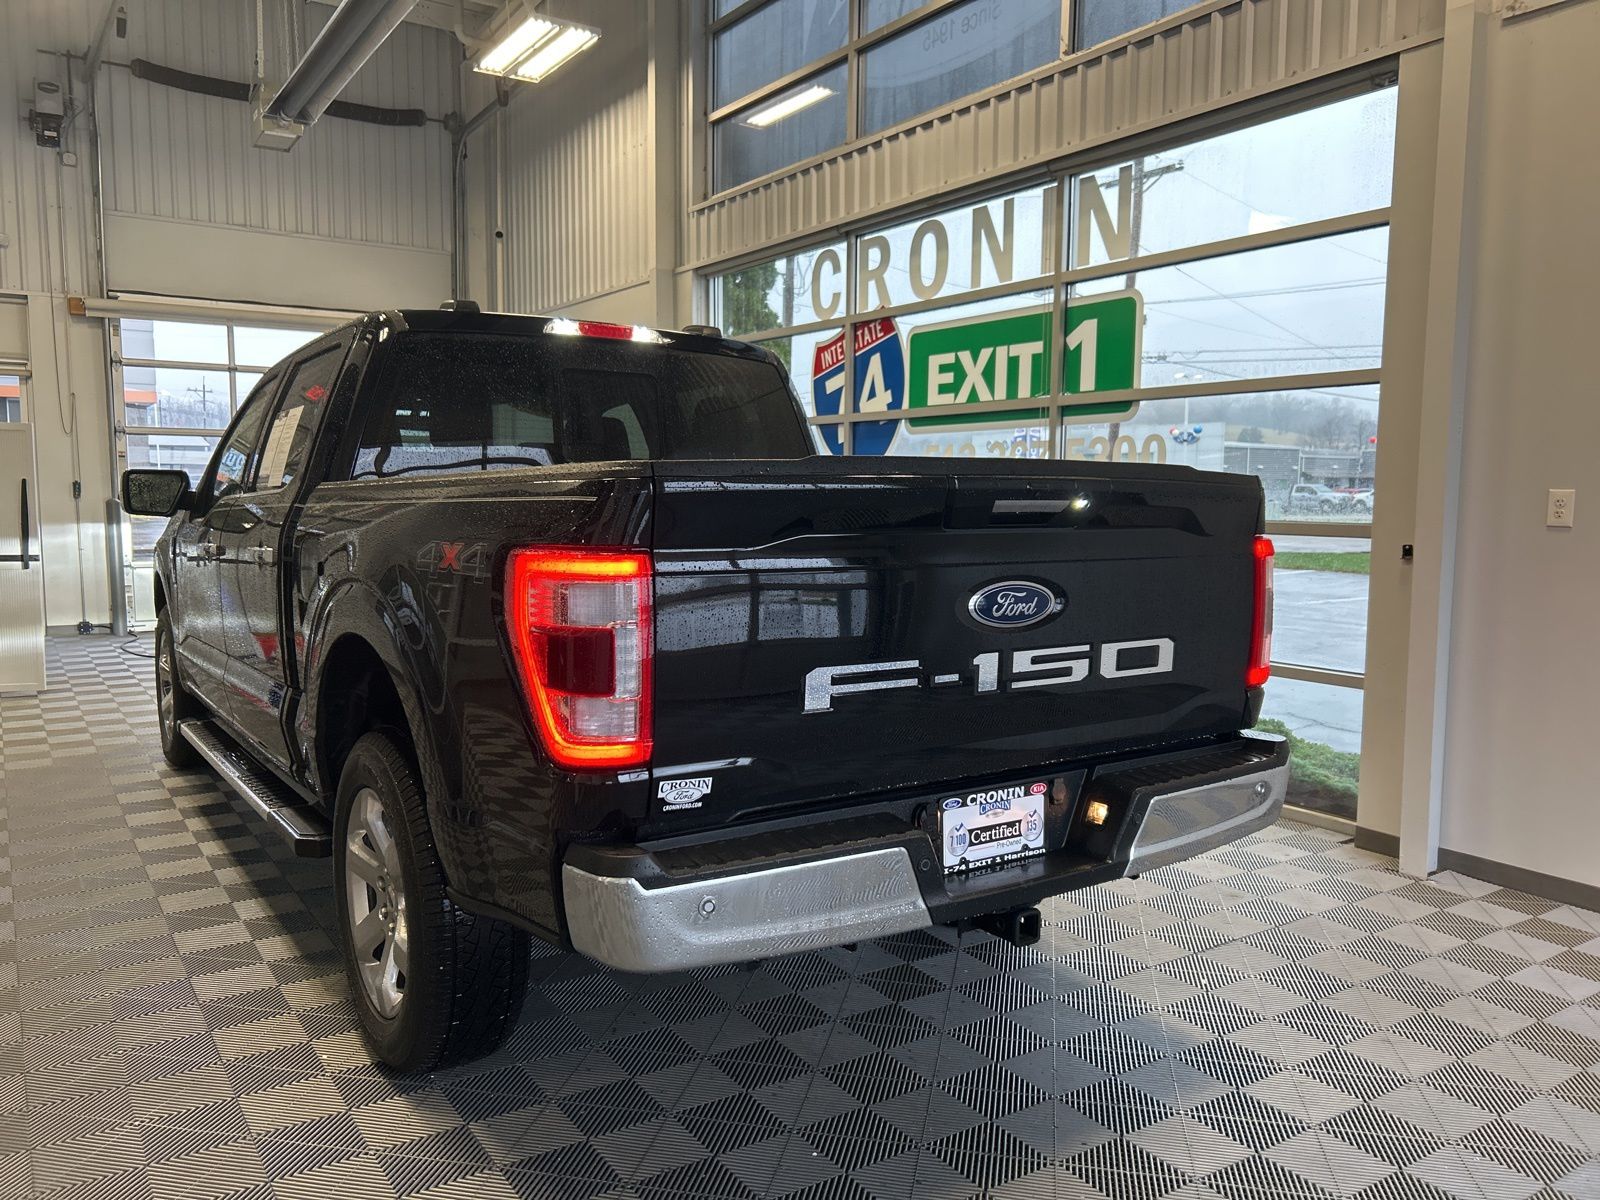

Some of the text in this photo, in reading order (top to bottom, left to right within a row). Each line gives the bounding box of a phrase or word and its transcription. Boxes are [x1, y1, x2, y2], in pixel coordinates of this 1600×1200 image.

[811, 164, 1134, 320] CRONIN
[927, 318, 1098, 406] EXIT 1
[824, 352, 893, 445] 74
[992, 591, 1037, 617] Ford
[804, 637, 1175, 714] F-150
[660, 779, 711, 793] CRONIN
[673, 790, 695, 801] Ford
[966, 786, 1025, 806] CRONIN
[980, 801, 1011, 814] CRONIN
[971, 823, 1020, 844] Certified
[943, 865, 967, 876] I-74
[969, 858, 993, 869] EXIT
